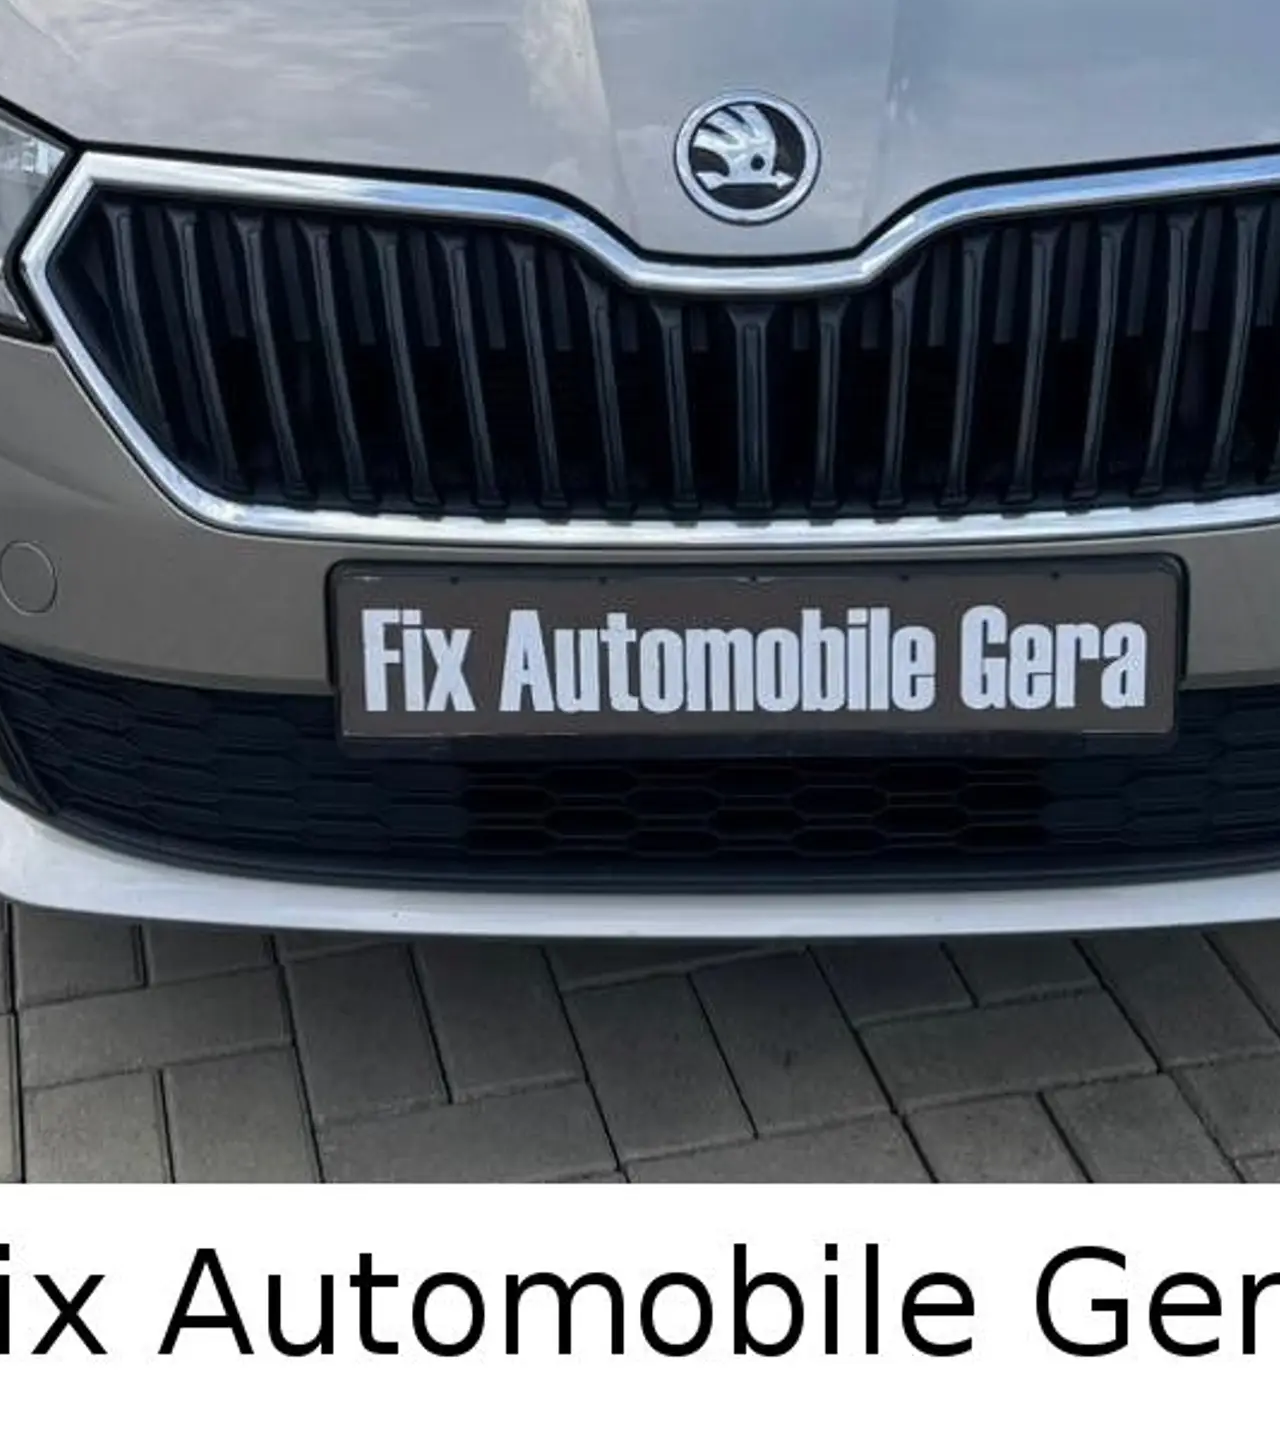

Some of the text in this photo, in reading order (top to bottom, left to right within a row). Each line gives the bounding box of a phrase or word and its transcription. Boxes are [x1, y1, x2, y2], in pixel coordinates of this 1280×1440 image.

[362, 605, 1147, 713] Fix Automobile Gera
